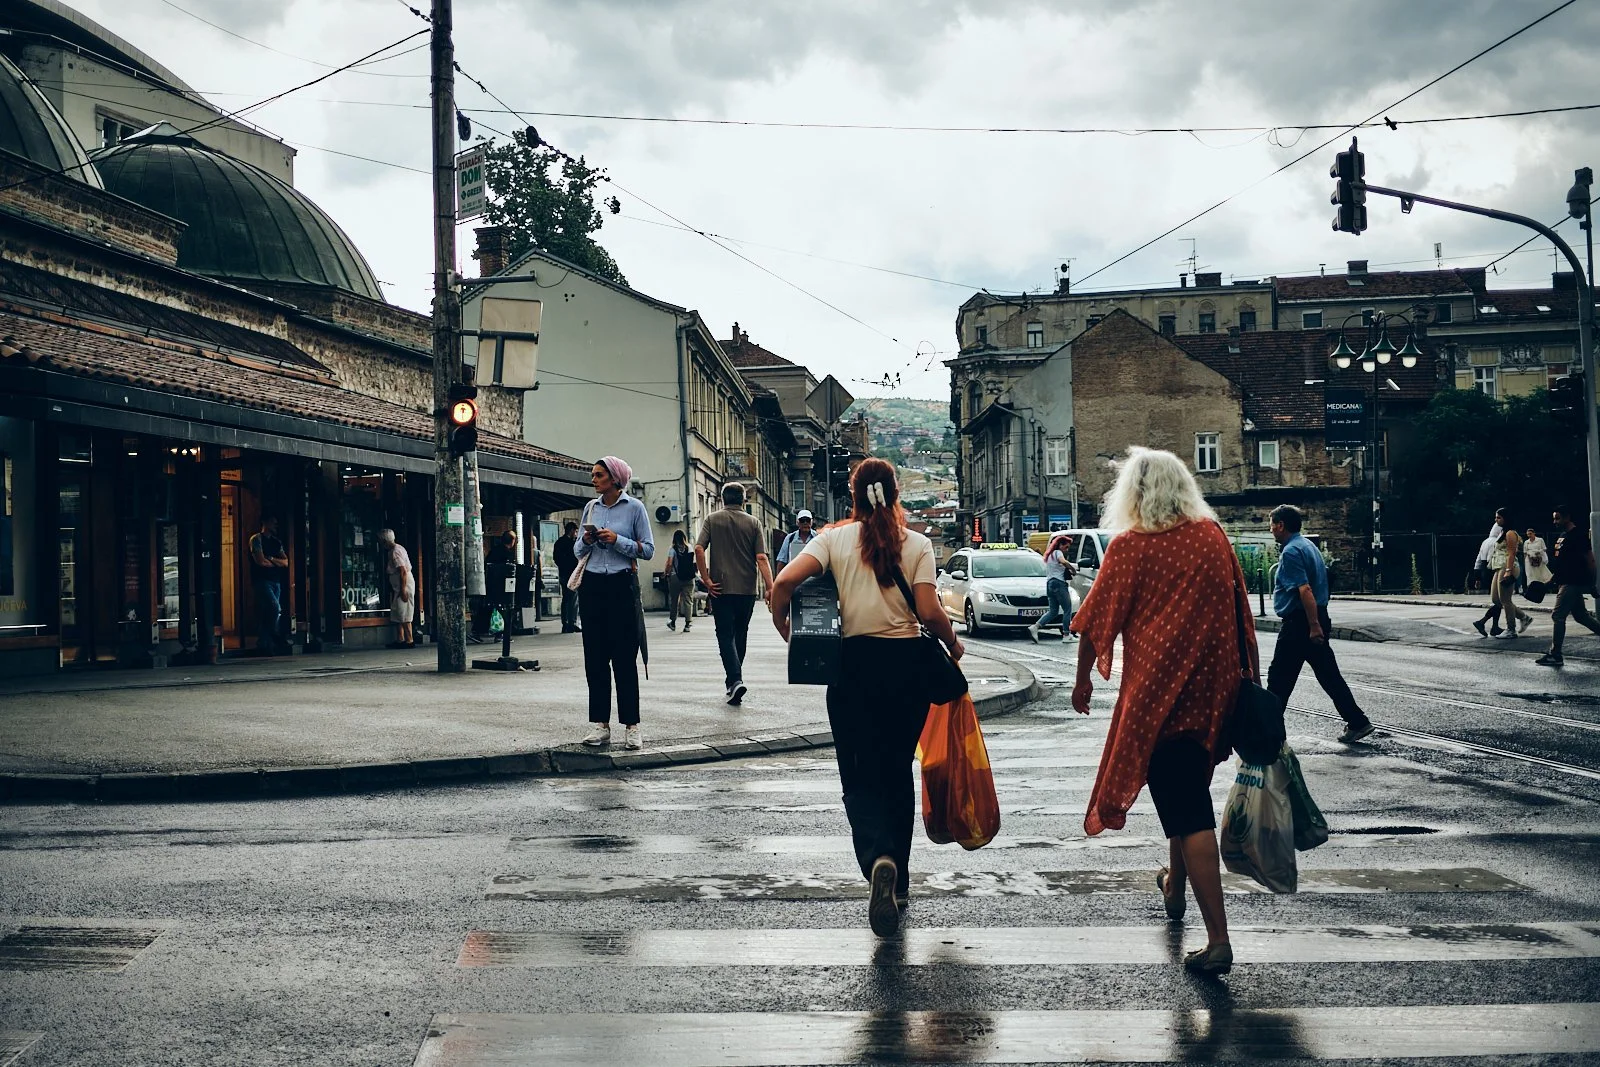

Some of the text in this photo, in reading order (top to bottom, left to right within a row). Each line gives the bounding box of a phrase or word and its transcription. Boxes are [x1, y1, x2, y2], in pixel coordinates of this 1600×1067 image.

[458, 154, 483, 171] STARAČKI
[461, 166, 482, 187] DOM
[466, 185, 483, 198] GREEN
